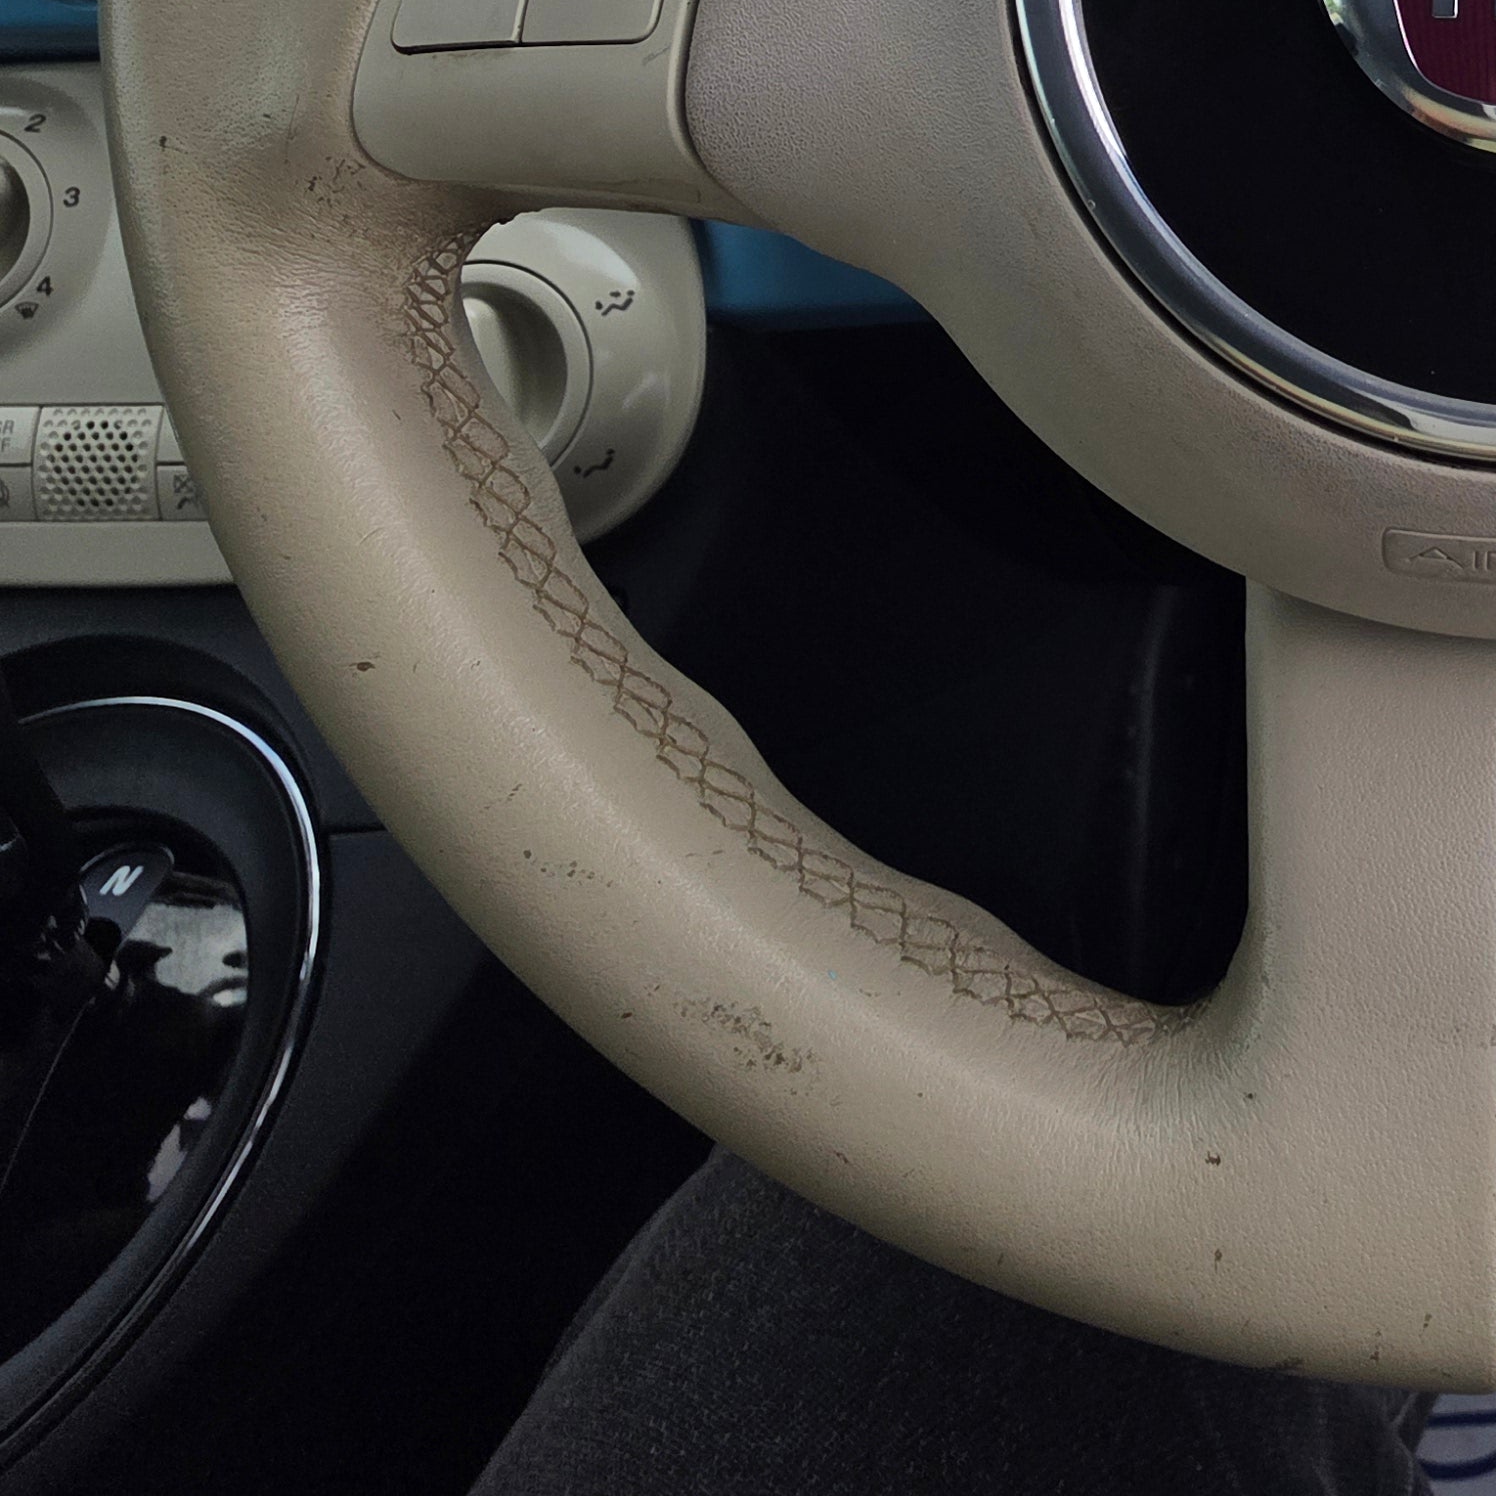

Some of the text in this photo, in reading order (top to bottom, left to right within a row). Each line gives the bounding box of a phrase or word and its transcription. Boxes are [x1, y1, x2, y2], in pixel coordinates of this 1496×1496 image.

[24, 113, 47, 133] 2
[62, 186, 81, 208] 3
[36, 275, 54, 297] 4
[99, 865, 144, 897] N
